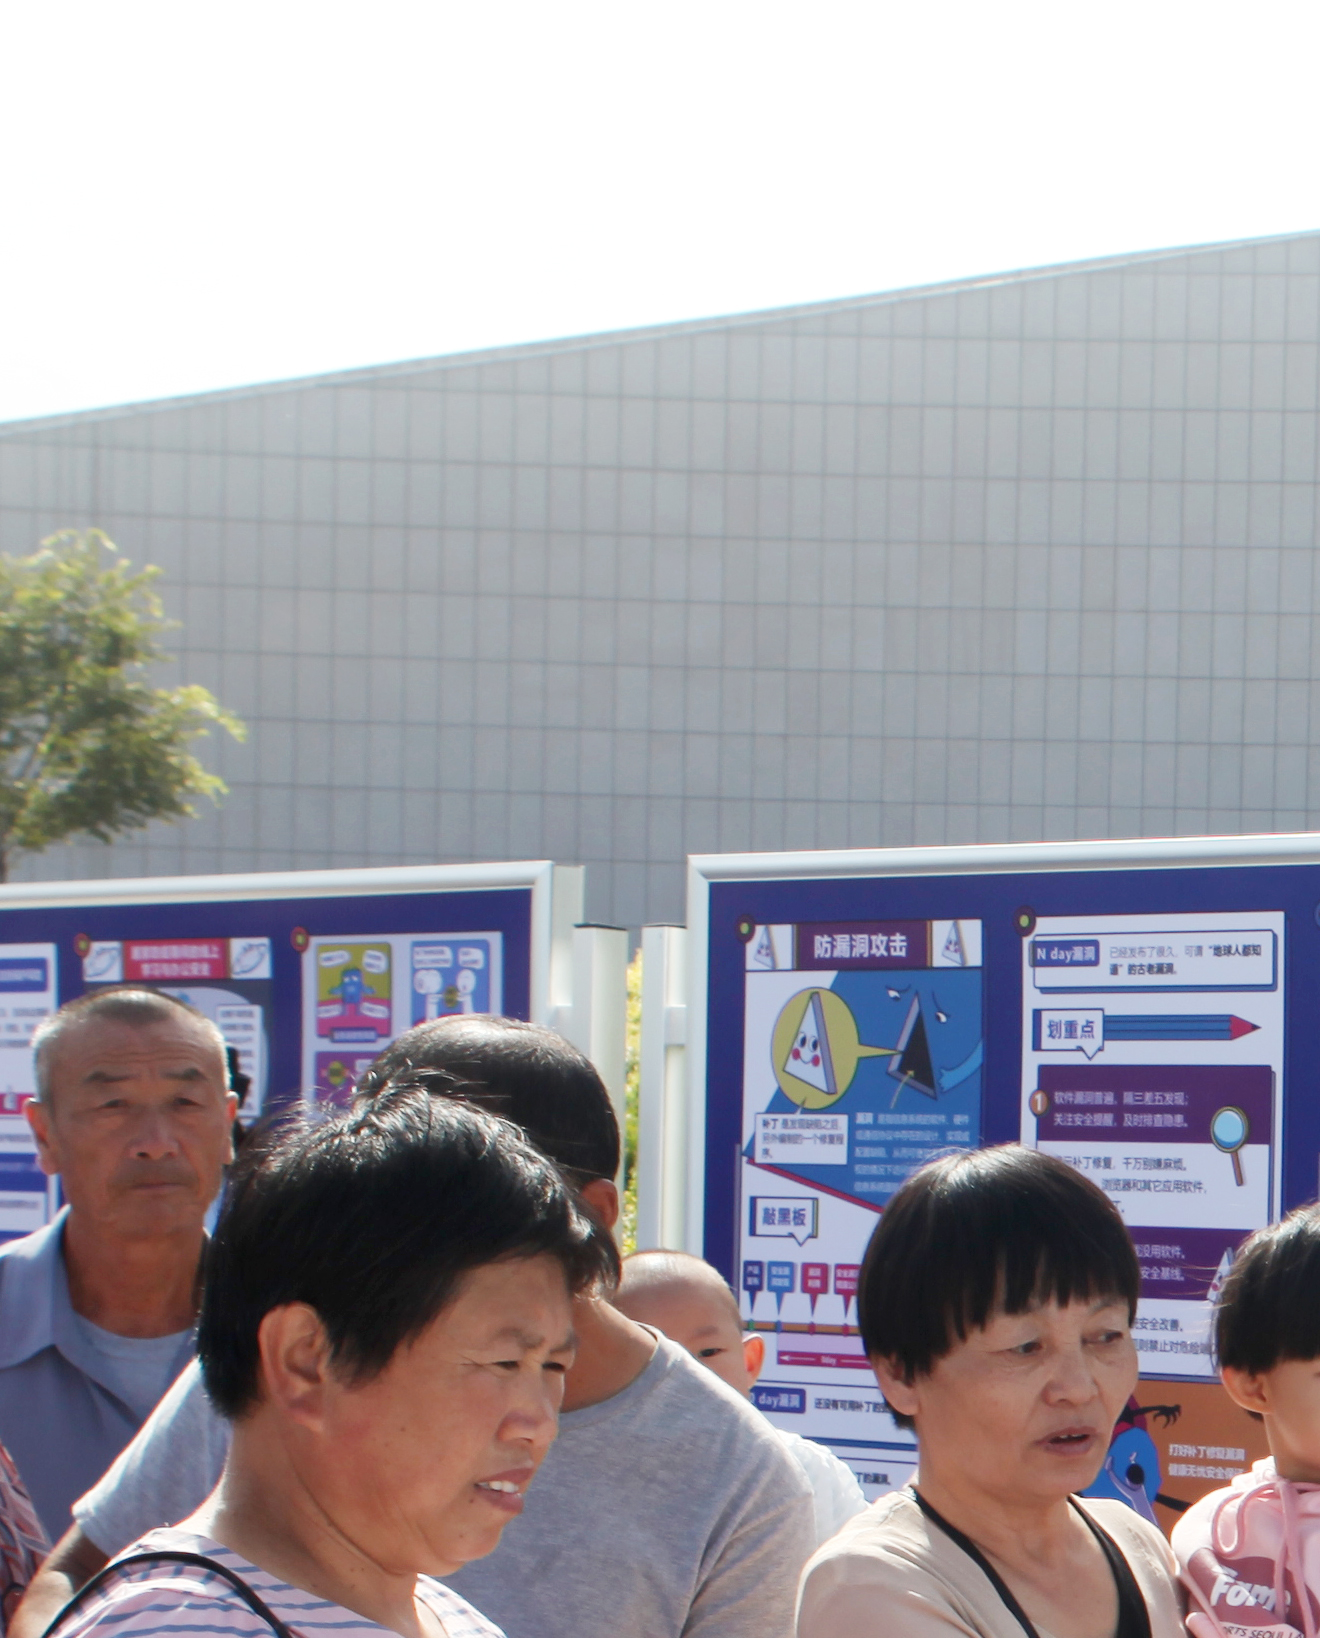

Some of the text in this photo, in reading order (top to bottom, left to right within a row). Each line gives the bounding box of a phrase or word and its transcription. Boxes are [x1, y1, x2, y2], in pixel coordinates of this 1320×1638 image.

[814, 934, 907, 958] 防漏洞攻击
[1037, 948, 1046, 960] N
[1047, 1019, 1095, 1040] 划重点
[1035, 1093, 1042, 1110] 1
[762, 1208, 806, 1228] 敲黑板
